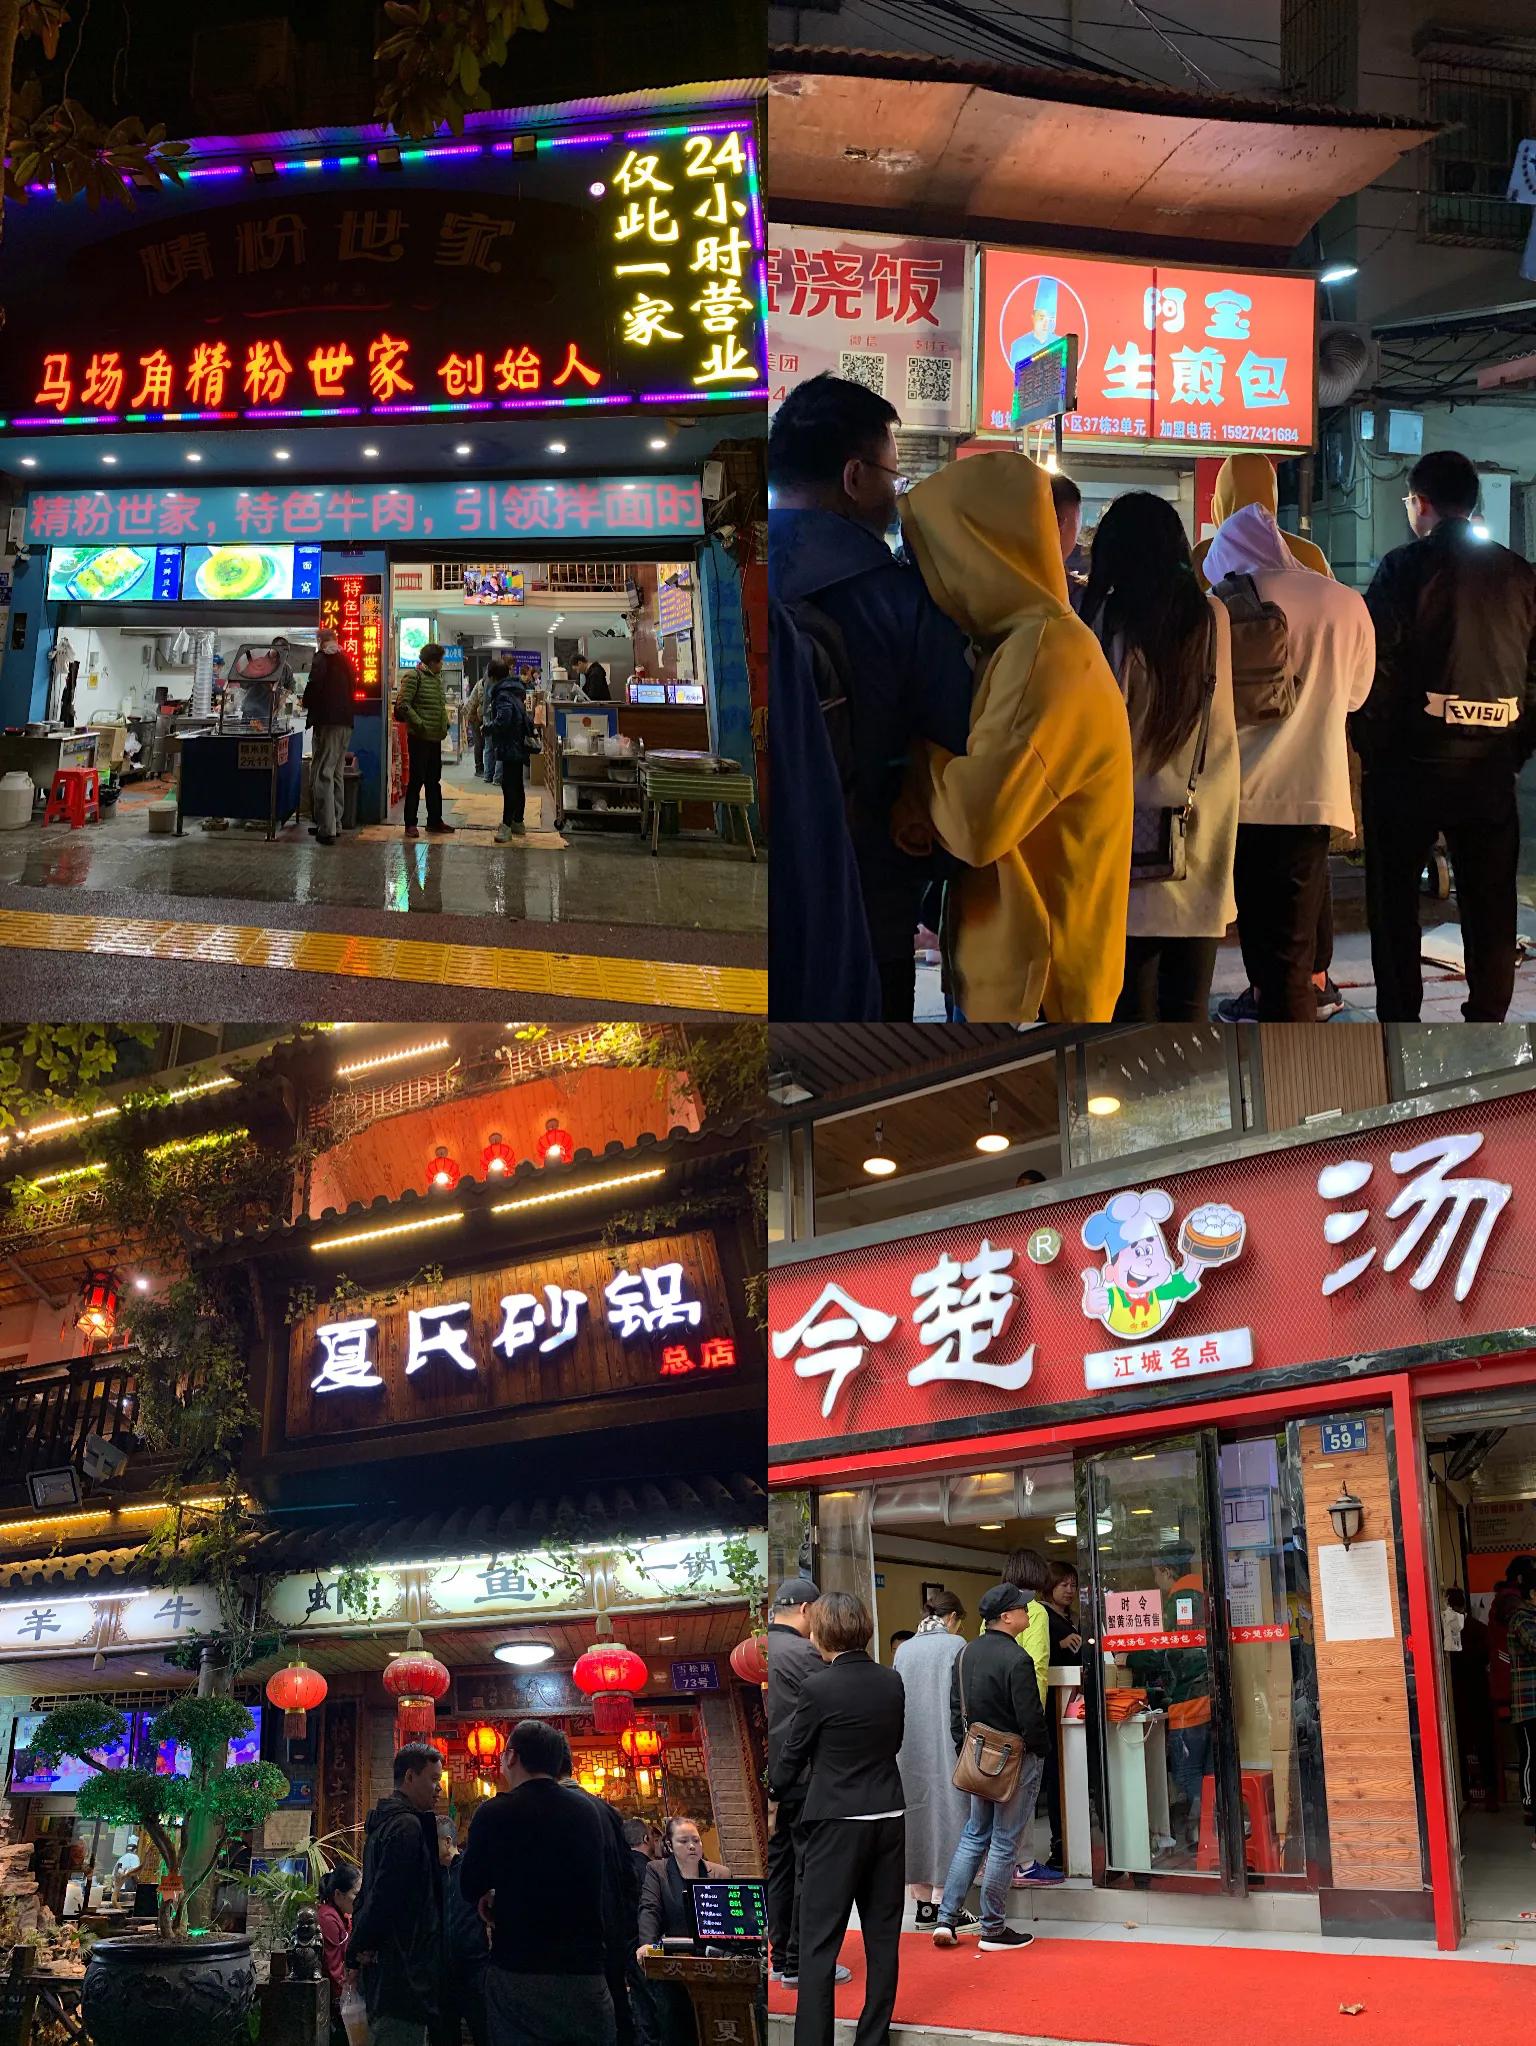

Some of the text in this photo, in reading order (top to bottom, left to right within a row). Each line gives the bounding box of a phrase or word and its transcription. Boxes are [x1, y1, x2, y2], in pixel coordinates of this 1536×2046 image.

[613, 150, 684, 346] 仅此一家
[685, 131, 758, 385] 24小时营业
[768, 248, 942, 326] 浇饭
[1143, 286, 1252, 340] 阿宝
[850, 335, 878, 347] 微信
[34, 334, 601, 410] 马场角精粉世家 创始人
[1101, 341, 1290, 409] 生煎包
[342, 581, 361, 660] 特色牛肉
[363, 625, 378, 684] 精粉世家
[1449, 705, 1504, 721] EVISU
[771, 1239, 1036, 1418] 今楚
[1317, 1132, 1513, 1302] 汤
[311, 1262, 701, 1394] 夏氏砂锅
[660, 1337, 736, 1376] 总店
[1113, 1341, 1221, 1378] 江城名点
[1330, 1432, 1352, 1450] 59
[644, 1541, 752, 1578] 一锅
[473, 1556, 536, 1605] 鱼
[154, 1595, 200, 1630] 牛
[1108, 1613, 1160, 1629] 蟹黄汤包有售
[1121, 1595, 1148, 1612] 时令
[17, 1608, 62, 1641] 羊
[1107, 1634, 1146, 1648] 今楚汤包
[1150, 1631, 1191, 1645] 今楚汤包
[1241, 1626, 1285, 1640] 今楚汤包
[683, 1677, 710, 1688] 73号
[713, 2019, 745, 2043] 夏
